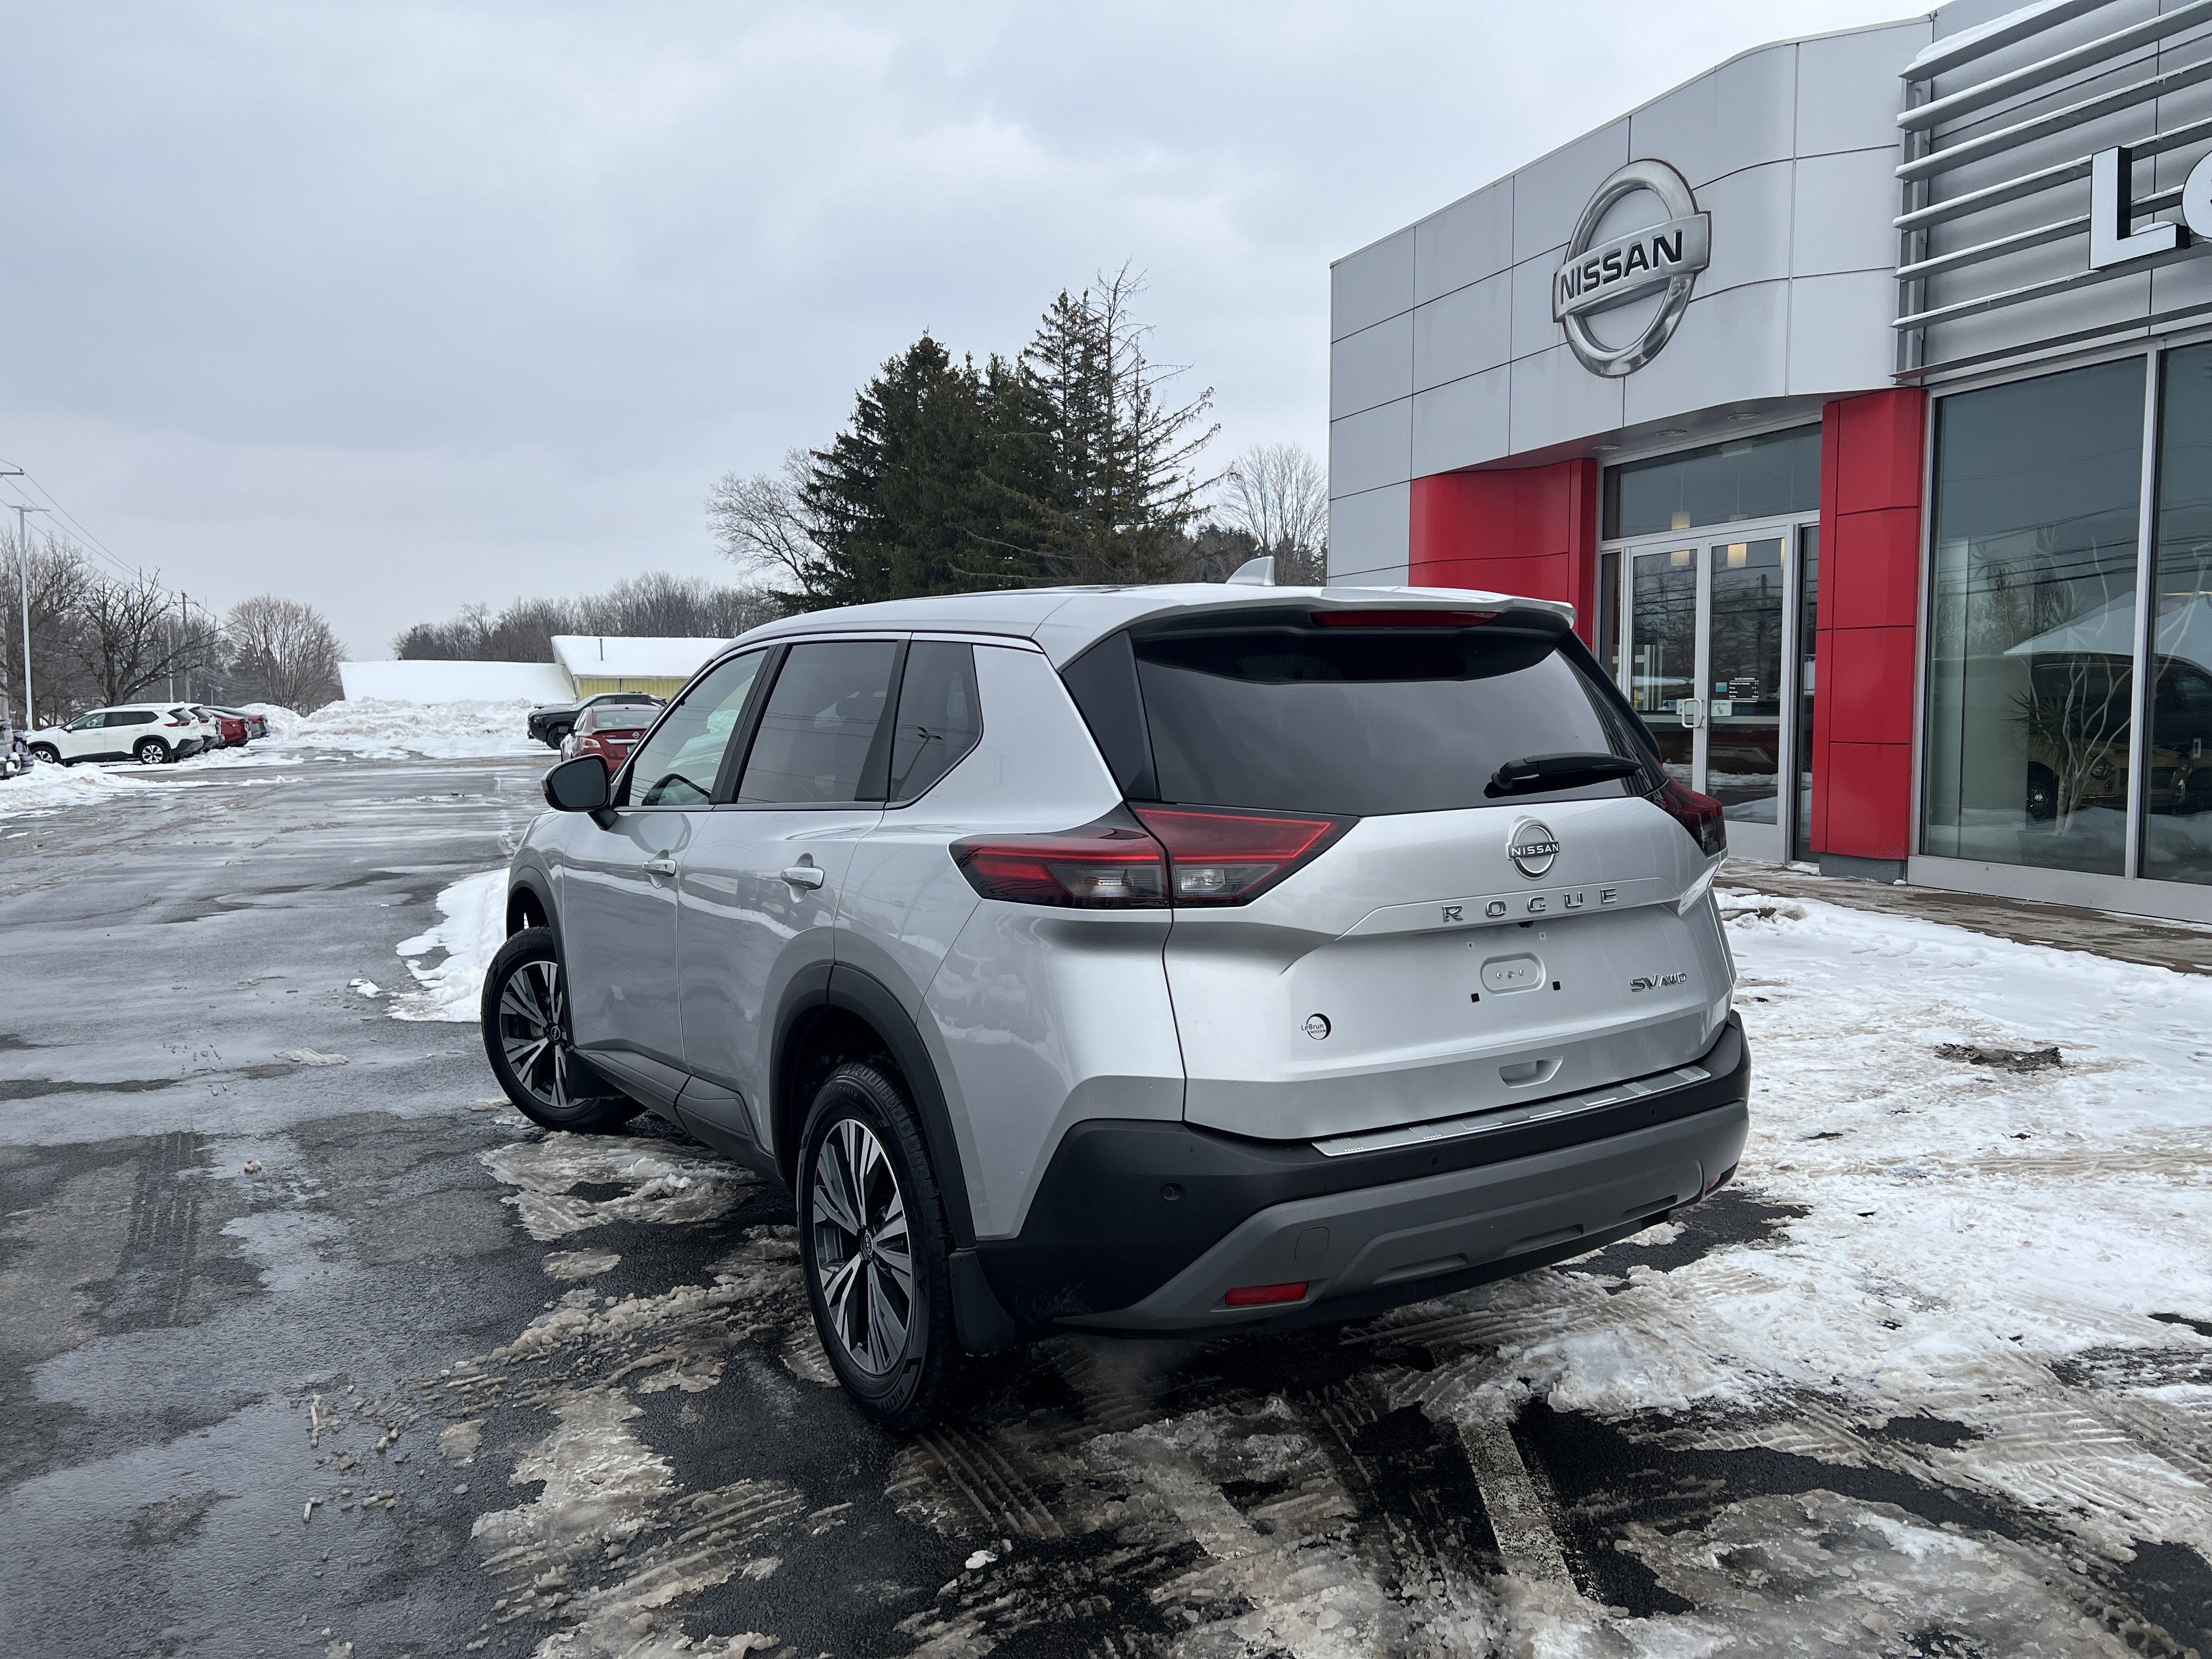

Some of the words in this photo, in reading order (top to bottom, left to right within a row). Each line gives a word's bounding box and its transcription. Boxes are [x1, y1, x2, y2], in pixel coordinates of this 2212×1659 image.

[1560, 229, 1683, 305] NISSAN
[1511, 843, 1559, 856] NISSAN
[1442, 888, 1618, 922] ROGUE
[1630, 974, 1658, 992] SV
[1658, 973, 1687, 988] AWD
